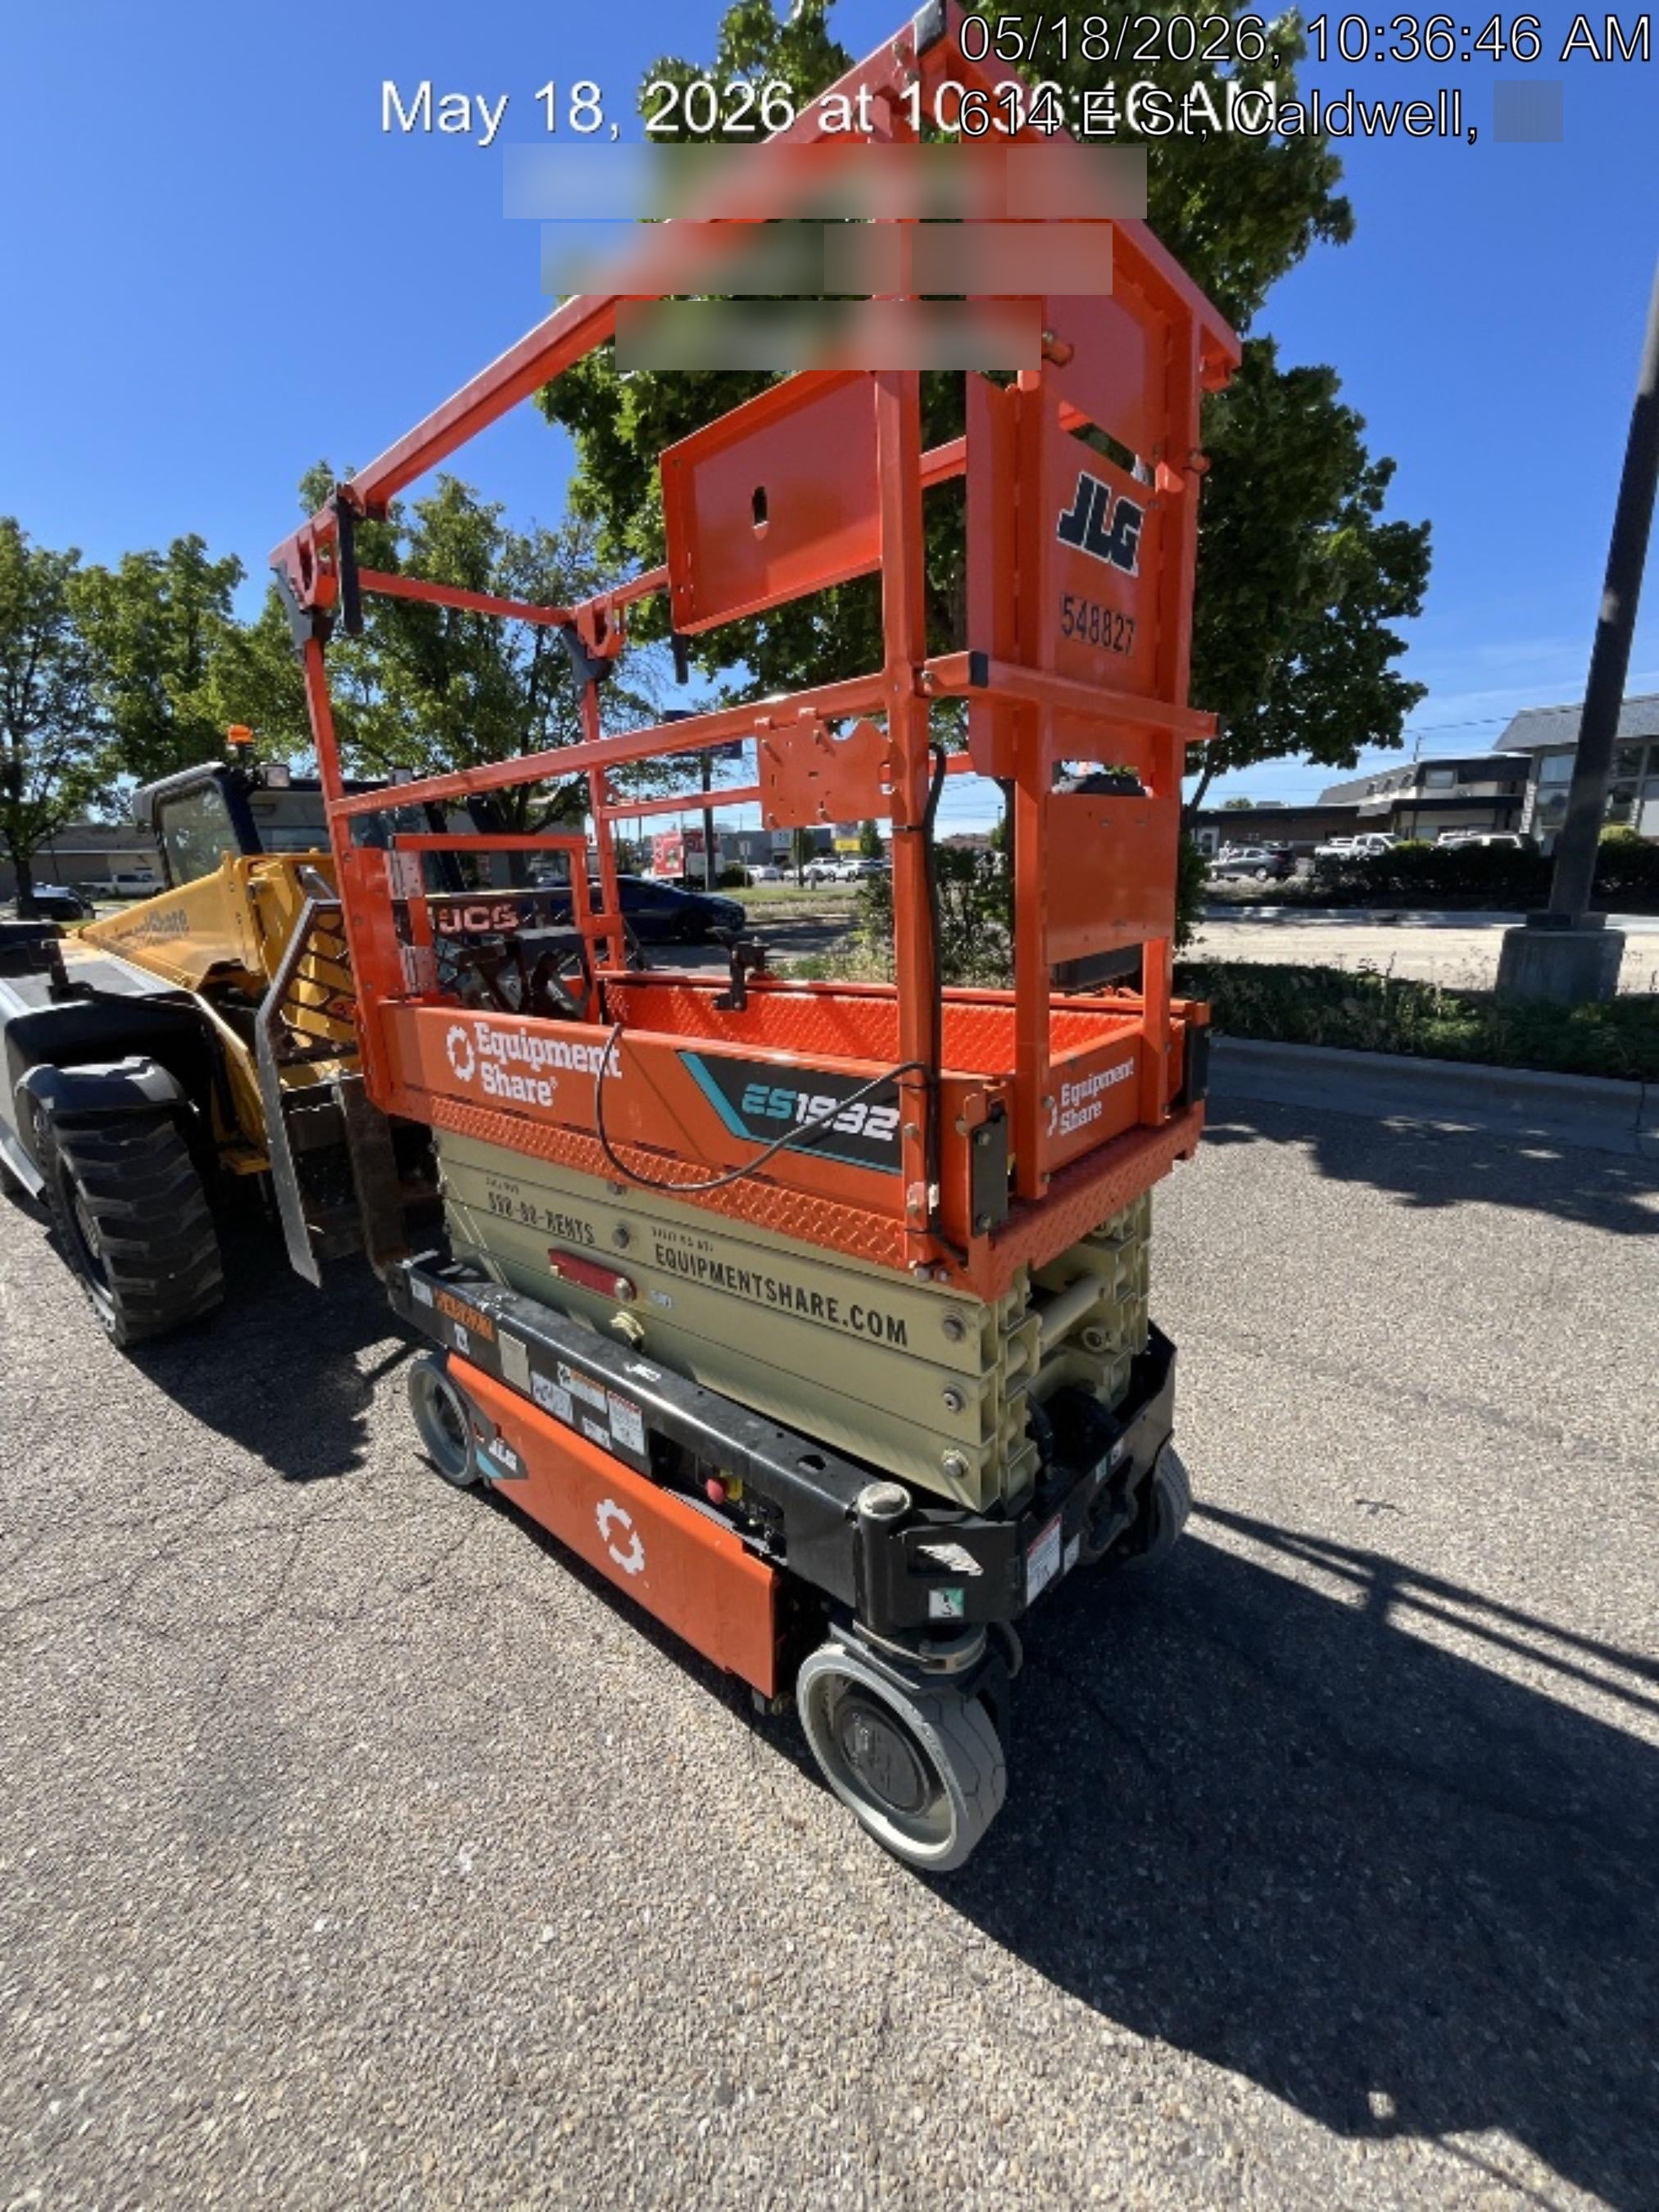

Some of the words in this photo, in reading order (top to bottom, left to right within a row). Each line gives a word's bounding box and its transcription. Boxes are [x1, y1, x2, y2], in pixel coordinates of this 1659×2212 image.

[1057, 471, 1145, 578] JLG
[1060, 596, 1136, 655] 548827
[474, 1022, 623, 1080] Equipment
[1060, 1056, 1135, 1108] Equipment
[741, 1083, 900, 1142] ES1932
[1060, 1100, 1102, 1136] Share
[655, 1243, 909, 1348] EQUIPMENTSHARE.COM
